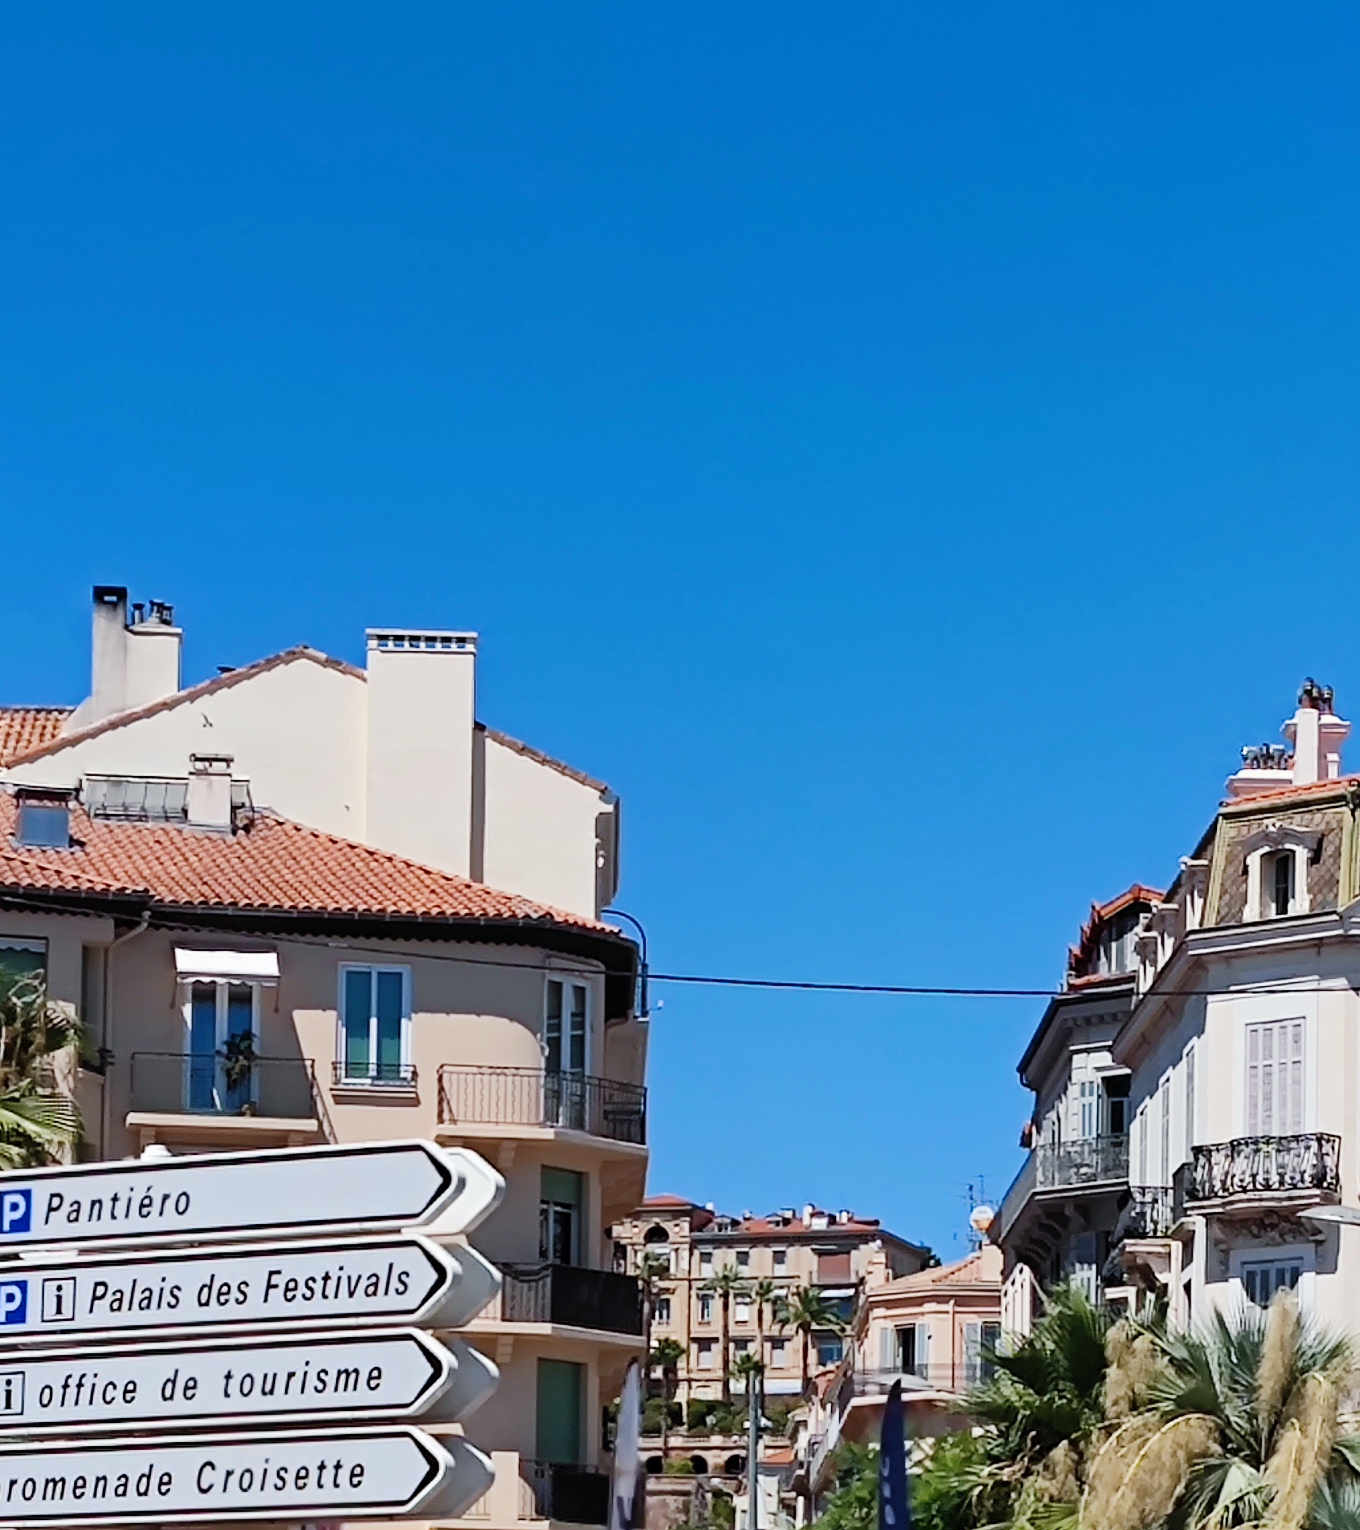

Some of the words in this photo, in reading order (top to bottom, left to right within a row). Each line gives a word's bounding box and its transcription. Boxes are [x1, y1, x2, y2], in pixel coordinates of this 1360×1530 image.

[2, 1193, 27, 1232] P
[44, 1185, 191, 1226] Pantiéro
[89, 1276, 182, 1314] Palais
[197, 1273, 250, 1308] des
[262, 1262, 410, 1303] Festivals
[39, 1372, 138, 1408] office
[161, 1368, 198, 1402] de
[223, 1360, 383, 1399] tourisme
[196, 1457, 365, 1495] Croisette
